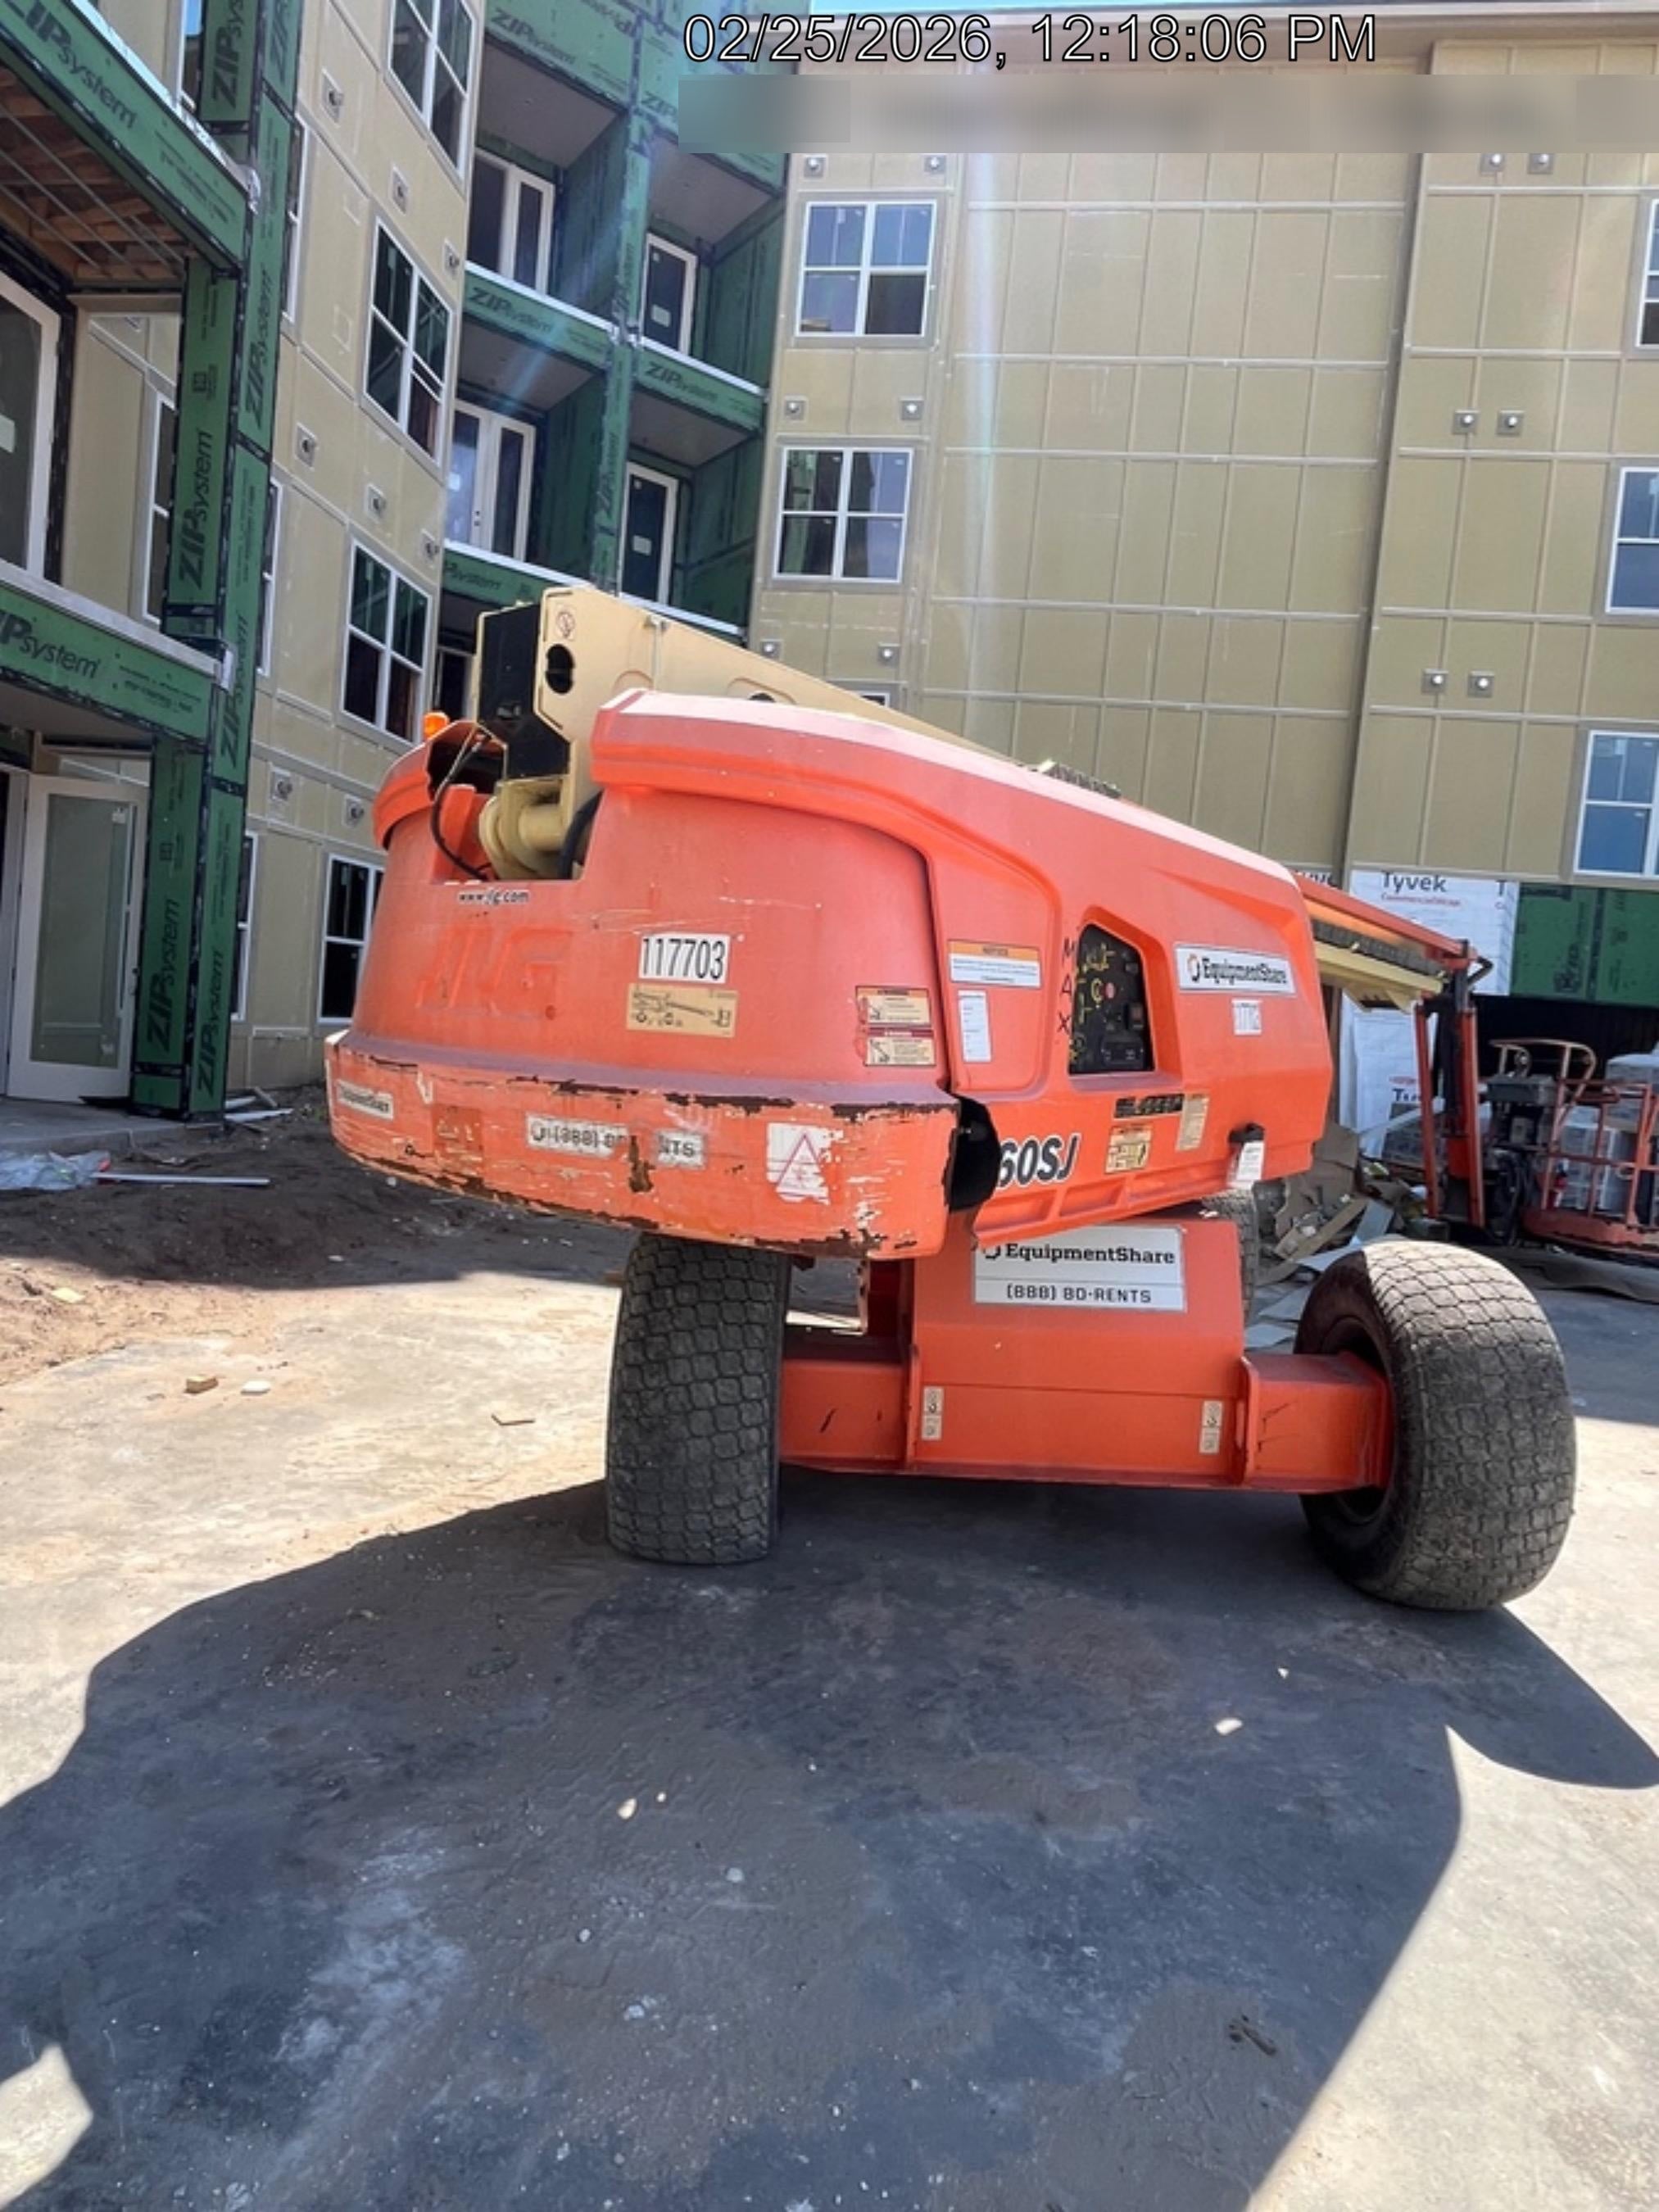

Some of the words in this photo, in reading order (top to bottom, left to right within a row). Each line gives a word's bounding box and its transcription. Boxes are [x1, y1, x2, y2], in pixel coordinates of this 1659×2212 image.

[1382, 871, 1447, 894] Tyvek
[642, 938, 726, 980] 117703
[1005, 1242, 1175, 1264] EquipmentShare
